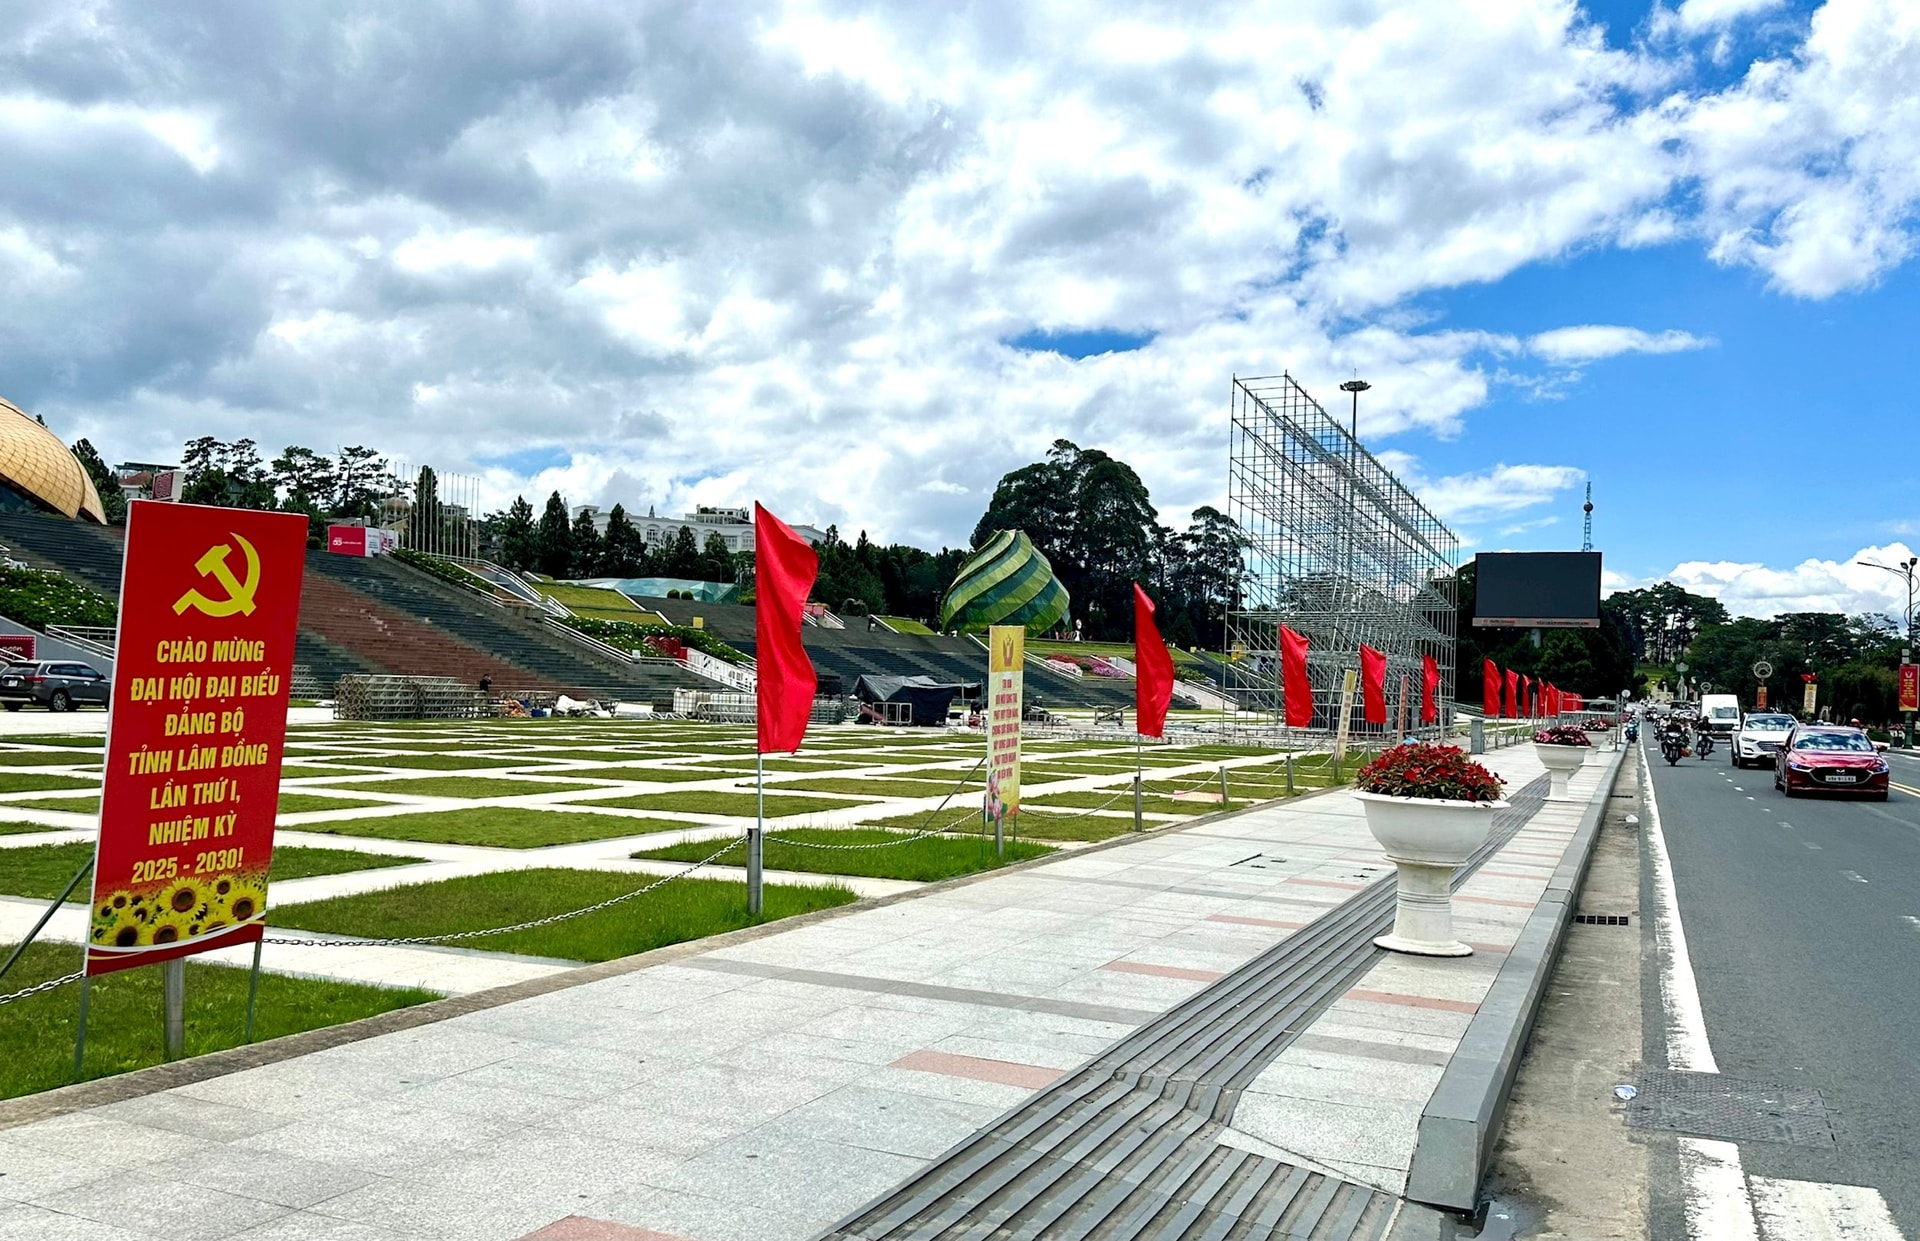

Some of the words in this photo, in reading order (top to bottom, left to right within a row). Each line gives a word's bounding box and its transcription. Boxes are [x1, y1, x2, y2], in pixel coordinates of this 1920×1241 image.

[157, 636, 207, 663] CHÀO
[211, 636, 265, 663] MỪNG
[130, 677, 165, 705] ĐẠI
[169, 673, 202, 704] HỘI
[205, 676, 237, 702] ĐẠI
[240, 667, 280, 697] BIỂU
[164, 706, 216, 736] ĐẢNG
[220, 707, 246, 736] BỘ
[128, 744, 173, 776] TỈNH
[176, 744, 218, 773] LÂM
[220, 738, 269, 768] ĐỒNG
[150, 779, 188, 810] LẦN
[193, 777, 228, 805] THỨ
[230, 780, 241, 804] I,
[148, 815, 210, 846] NHIỆM
[213, 810, 237, 838] KỲ
[131, 857, 178, 884] 2025
[195, 847, 244, 874] 2030!
